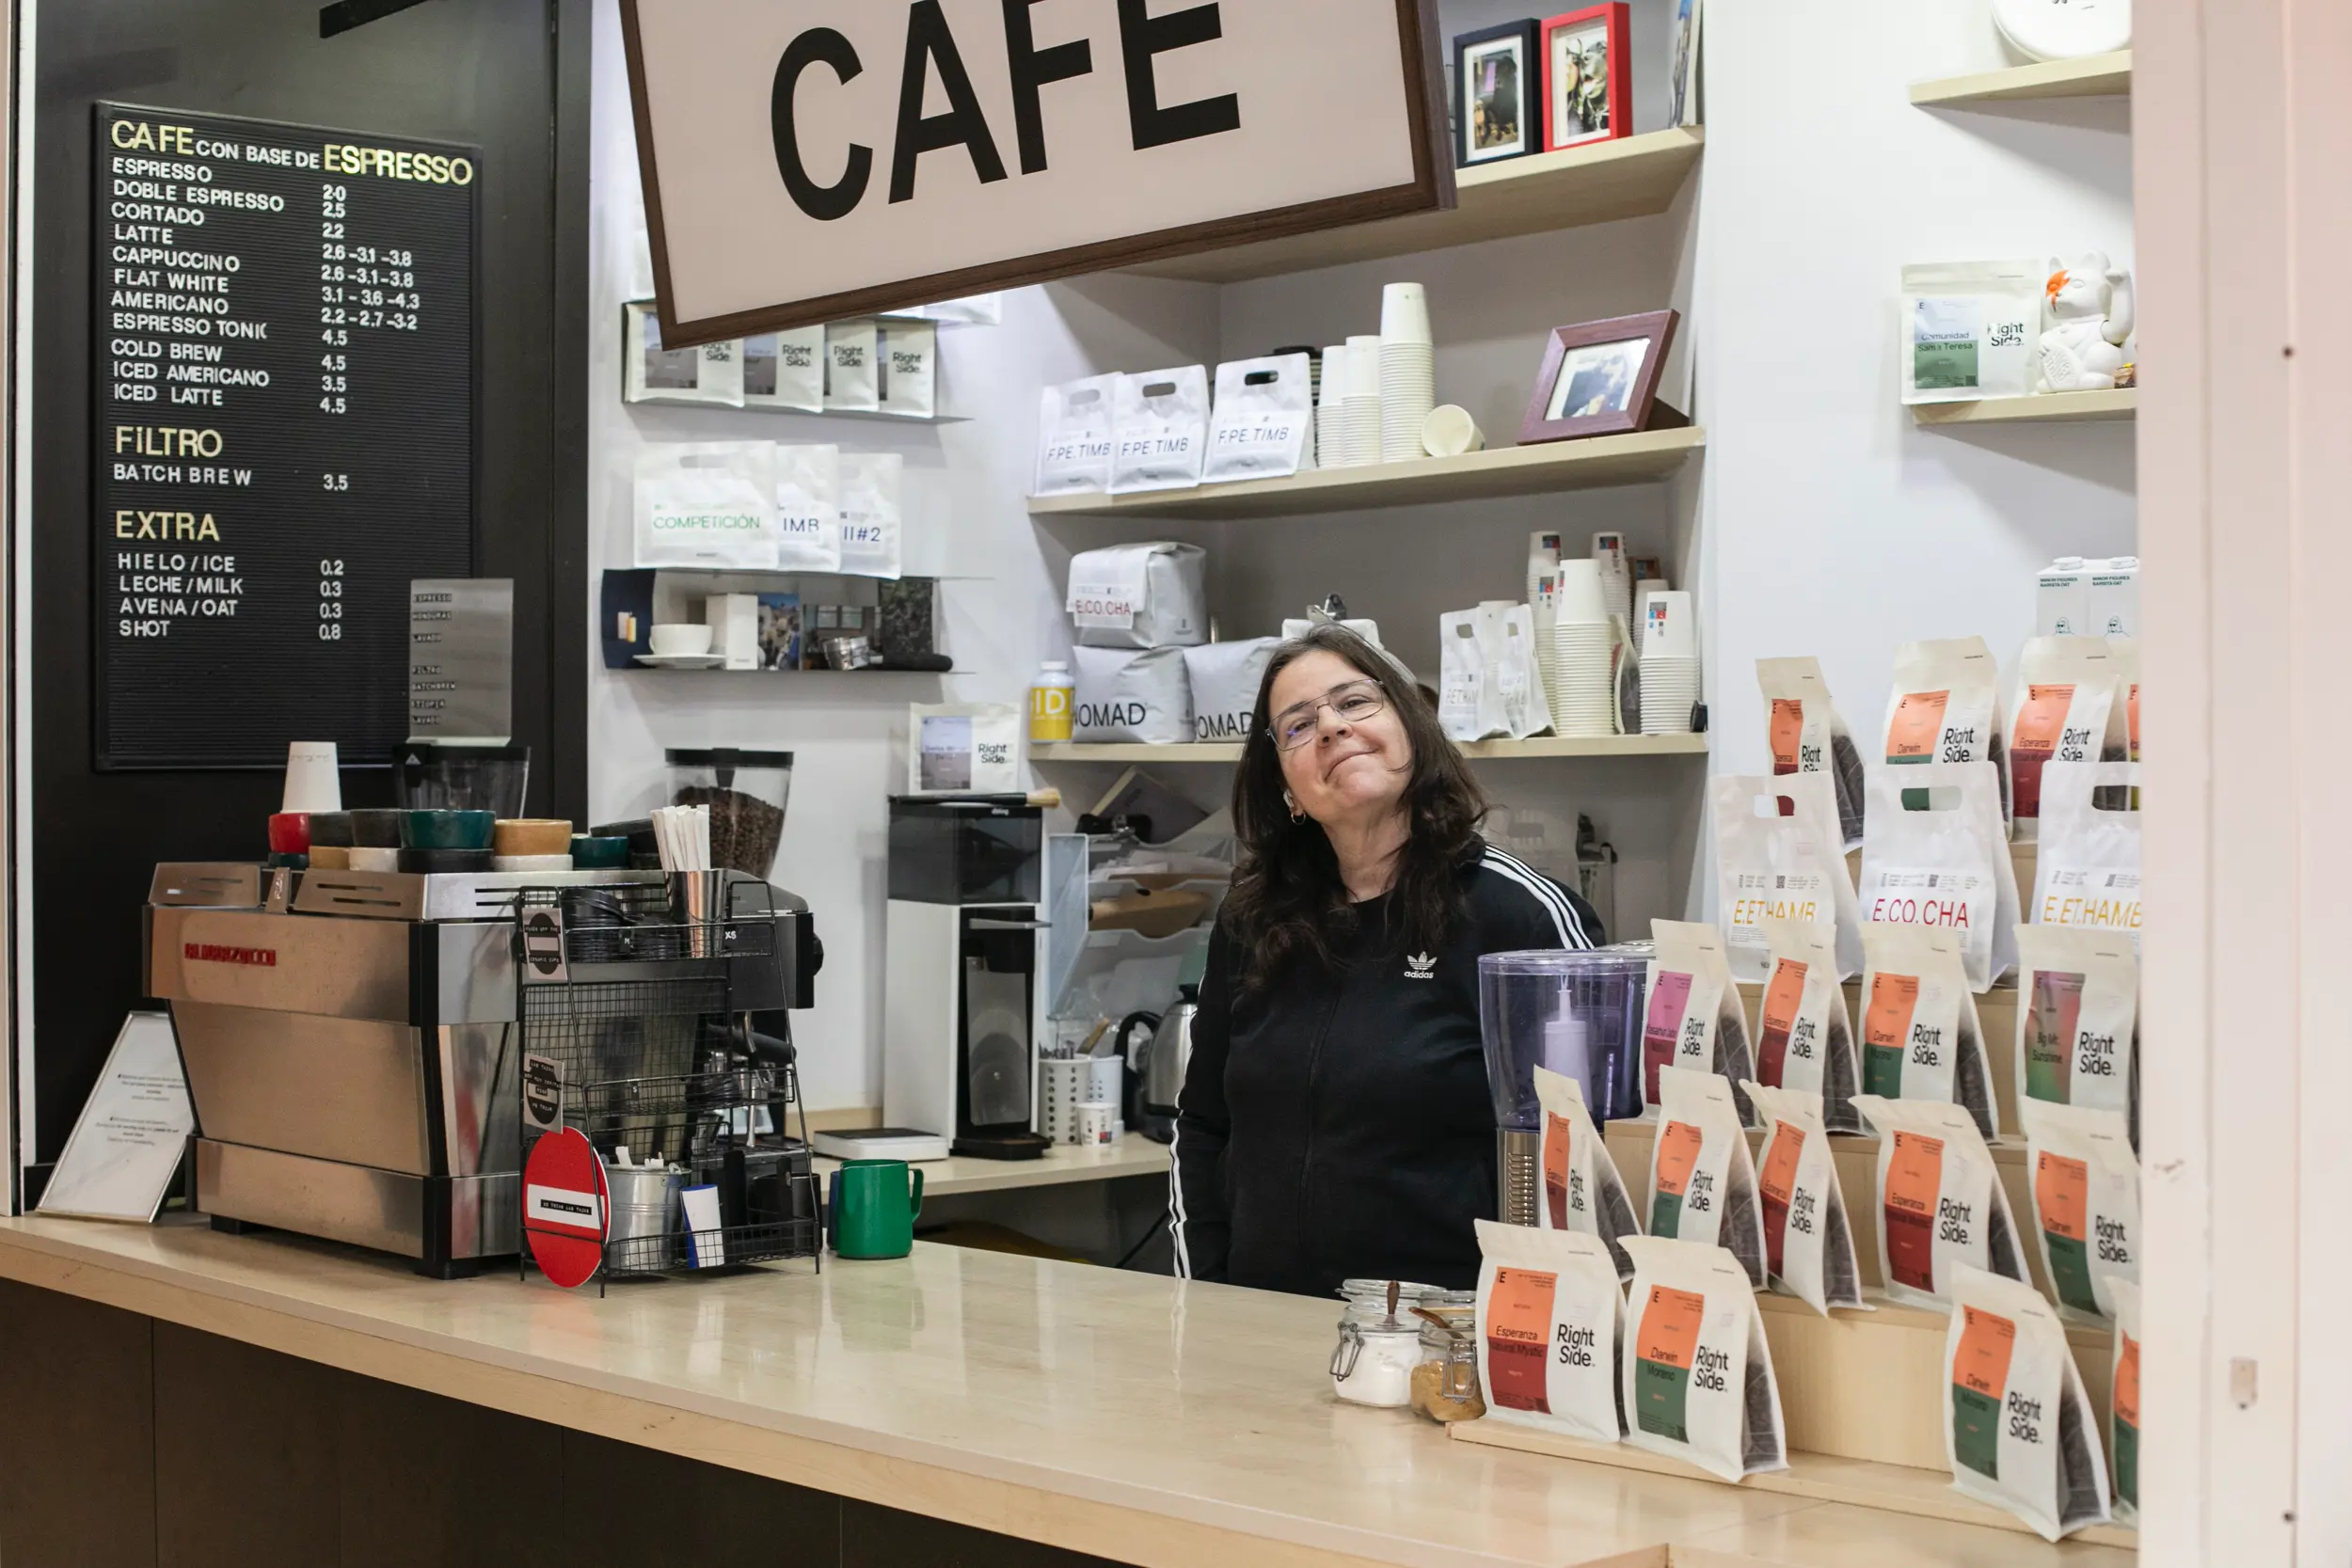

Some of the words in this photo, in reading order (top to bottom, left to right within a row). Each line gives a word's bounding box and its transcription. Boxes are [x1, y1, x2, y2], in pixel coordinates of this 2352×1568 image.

[111, 120, 194, 155] CAFE
[196, 139, 239, 160] CON
[246, 146, 292, 166] BASE
[295, 150, 320, 169] DE
[324, 144, 472, 185] ESPRESSO
[112, 157, 213, 182] ESPRESSO
[114, 180, 177, 202] DOBLE
[186, 187, 284, 212] ESPRESSO
[322, 201, 346, 218] 2.5
[111, 202, 205, 226] CORTADO
[322, 222, 344, 239] 2.2
[114, 224, 173, 245] LATTE
[322, 243, 345, 261] 2.6
[112, 246, 240, 273] CAPPUCCINO
[321, 264, 344, 281] 2.6
[114, 269, 160, 289] FLAT
[167, 273, 229, 293] WHITE
[322, 286, 342, 303] 3.1
[360, 289, 384, 306] 3.6
[111, 291, 229, 315] AMERICANO
[321, 307, 345, 324] 2.2
[113, 313, 211, 336] ESPRESSO
[322, 329, 348, 346] 4.5
[111, 340, 162, 358] COLD
[170, 343, 222, 362] BREW
[321, 354, 346, 372] 4.5
[1944, 341, 1973, 351] Teresa
[114, 361, 158, 380] ICED
[167, 365, 269, 388] AMERICANO
[322, 375, 346, 392] 3.5
[114, 384, 156, 402] ICED
[171, 387, 223, 406] LATTE
[320, 396, 346, 414] 4.5
[114, 464, 181, 483] BATCH
[189, 467, 251, 486] BREW
[323, 473, 349, 491] 3.5
[116, 510, 220, 542] EXTRA
[653, 513, 760, 529] COMPETICIÓN
[320, 560, 344, 576] 0.2
[319, 580, 342, 597] 0.3
[319, 602, 342, 619] 0.3
[119, 619, 170, 637] SHOT
[318, 624, 342, 641] 0.8
[978, 743, 1007, 755] Right
[1898, 743, 1921, 754] Darwin
[1944, 728, 1974, 746] Right
[2062, 728, 2090, 746] Right
[1872, 898, 1969, 928] E.CO.CHA
[724, 930, 737, 941] XS
[1404, 970, 1434, 979] adidas
[1685, 1017, 1705, 1037] Right
[1795, 1017, 1816, 1039] Right
[1913, 1023, 1941, 1048] Right
[2078, 1031, 2115, 1057] Right
[1570, 1168, 1583, 1192] Right
[1692, 1169, 1713, 1192] Right
[1794, 1186, 1816, 1214] Right
[1939, 1197, 1972, 1224] Right
[2095, 1215, 2126, 1243] Right
[1496, 1324, 1538, 1340] Esperanza
[1557, 1323, 1596, 1350] Right
[1650, 1346, 1678, 1362] Darwin
[1696, 1345, 1729, 1372] Right
[2008, 1391, 2042, 1422] Right
